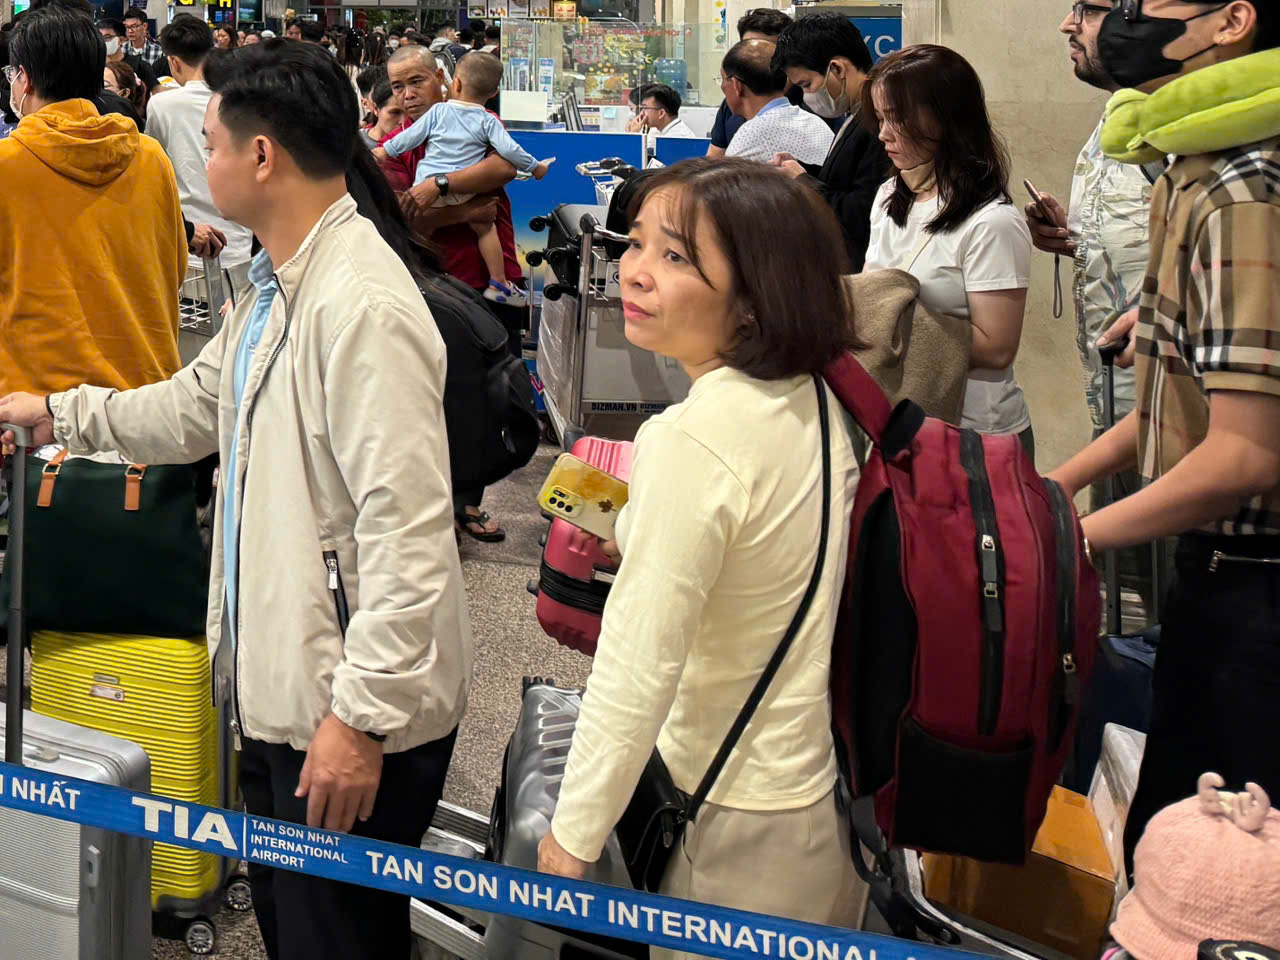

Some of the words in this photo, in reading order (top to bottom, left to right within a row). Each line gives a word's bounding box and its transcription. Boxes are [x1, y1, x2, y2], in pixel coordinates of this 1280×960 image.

[591, 402, 637, 411] BIZMAN.VN
[11, 780, 81, 811] NHẤT
[131, 796, 238, 851] TIA
[251, 819, 275, 835] TAN
[278, 824, 304, 840] SON
[307, 829, 341, 847] NHAT
[250, 834, 349, 864] INTERNATIONAL
[250, 848, 306, 869] AIRPORT
[365, 850, 423, 884] TAN
[433, 865, 498, 900] SON
[509, 880, 595, 918] NHAT
